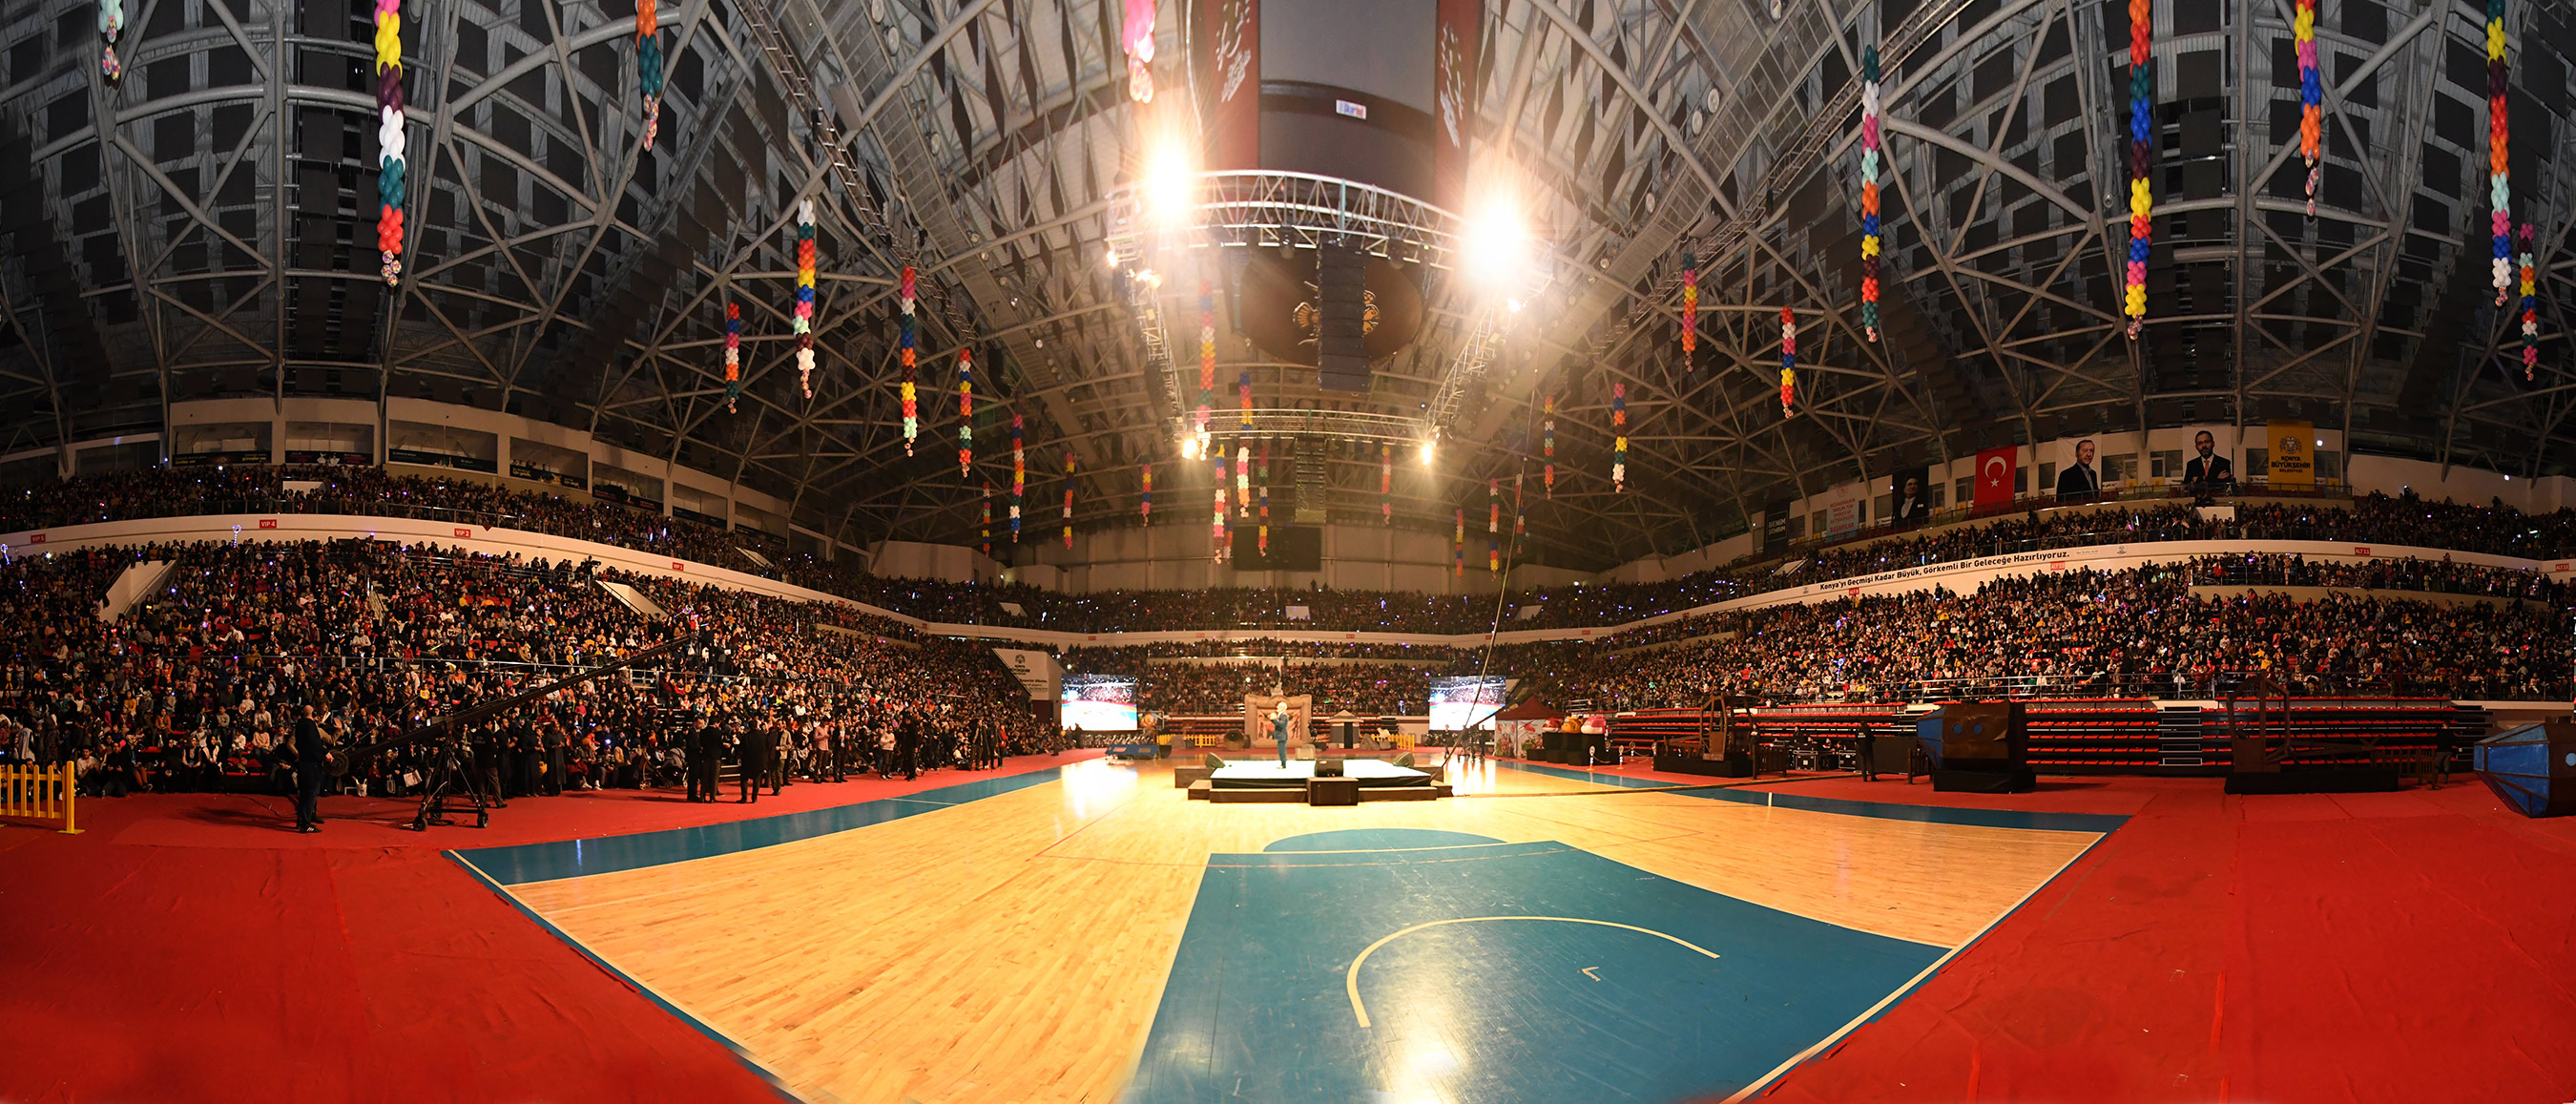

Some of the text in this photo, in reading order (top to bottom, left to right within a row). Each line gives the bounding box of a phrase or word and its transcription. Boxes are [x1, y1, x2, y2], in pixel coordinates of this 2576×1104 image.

[1820, 581, 1846, 590] Konya'yı
[1897, 569, 1922, 579] Büyük,
[1923, 562, 1958, 573] Görkemli
[1974, 557, 2011, 567] Geleceğe
[2013, 551, 2070, 563] Hazırlıyoruz.
